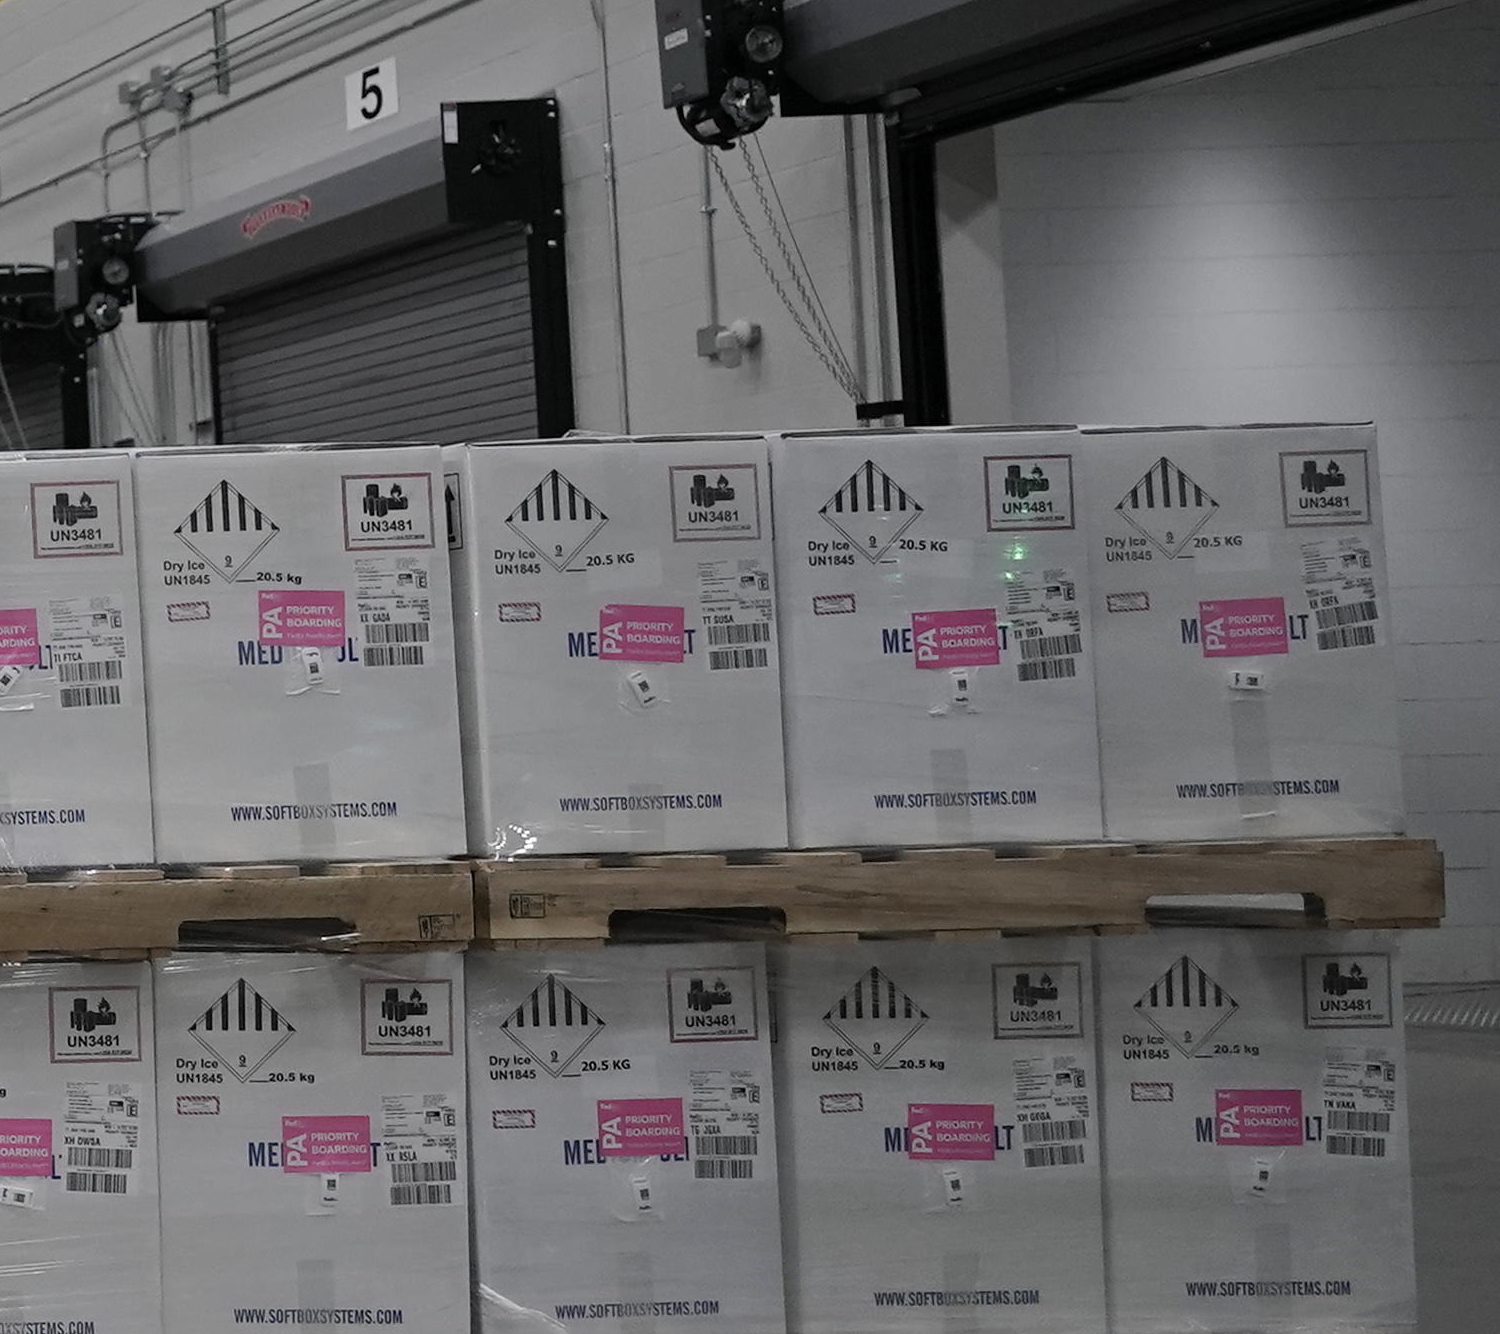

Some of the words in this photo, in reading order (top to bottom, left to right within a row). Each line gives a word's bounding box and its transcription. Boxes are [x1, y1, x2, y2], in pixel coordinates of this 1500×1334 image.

[362, 67, 382, 119] 5
[1002, 502, 1052, 514] UN3481
[1299, 496, 1349, 509] UN3481
[688, 511, 739, 523] UN3481
[361, 520, 412, 533] UN3481
[50, 529, 102, 541] UN3481
[808, 541, 829, 553] Dry
[832, 541, 850, 551] Ice
[899, 539, 926, 551] 20.5
[930, 541, 948, 551] KG
[495, 549, 515, 561] Dry
[518, 549, 535, 559] Ice
[586, 554, 613, 566] 20.5
[617, 553, 634, 565] KG
[809, 555, 854, 566] UN1845
[164, 560, 184, 573] Dry
[188, 560, 205, 570] Ice
[495, 564, 541, 575] UN1845
[164, 575, 210, 585] UN1845
[257, 572, 282, 583] 20.5
[286, 573, 302, 585] kg
[287, 605, 334, 615] PRIORITY
[262, 607, 283, 640] PA
[287, 618, 341, 628] BOARDING
[627, 621, 673, 632] PRIORITY
[941, 626, 986, 636] PRIORITY
[602, 621, 622, 654] PA
[627, 634, 680, 644] BOARDING
[941, 637, 994, 648] BOARDING
[918, 629, 939, 662] PA
[560, 795, 721, 811] WWW.SOFTBOXSYSTEMS.COM
[875, 791, 1036, 807] WWW.SOFTBOXSYSTEMS.COM
[231, 803, 397, 821] WWW.SOFTBOXSYSTEMS.COM
[1320, 1000, 1372, 1011] UN3481
[685, 1015, 736, 1027] UN3481
[1010, 1010, 1061, 1022] UN3481
[378, 1025, 431, 1037] UN3481
[67, 1035, 119, 1047] UN3481
[1123, 1035, 1144, 1048] Dry
[1147, 1035, 1165, 1045] Ice
[1123, 1049, 1169, 1060] UN1845
[1214, 1044, 1240, 1055] 20.5
[1244, 1045, 1259, 1056] kg
[176, 1058, 197, 1070] Dry
[200, 1058, 218, 1068] Ice
[490, 1056, 510, 1068] Dry
[514, 1056, 531, 1066] Ice
[581, 1061, 608, 1072] 20.5
[611, 1060, 630, 1071] KG
[176, 1073, 223, 1083] UN1845
[269, 1072, 295, 1082] 20.5
[299, 1072, 315, 1083] kg
[490, 1069, 536, 1080] UN1845
[1244, 1104, 1290, 1115] PRIORITY
[626, 1114, 672, 1124] PRIORITY
[1220, 1106, 1241, 1139] PA
[1244, 1116, 1299, 1127] BOARDING
[311, 1132, 359, 1142] PRIORITY
[601, 1117, 621, 1149] PA
[626, 1126, 680, 1137] BOARDING
[286, 1134, 307, 1167] PA
[312, 1144, 367, 1155] BOARDING
[1186, 1281, 1351, 1296] WWW.SOFTBOXSYSTEMS.COM
[874, 1290, 1039, 1307] WWW.SOFTBOXSYSTEMS.COM
[555, 1301, 719, 1319] WWW.SOFTBOXSYSTEMS.COM
[234, 1308, 402, 1325] WWW.SOFTBOXSYSTEMS.COM
